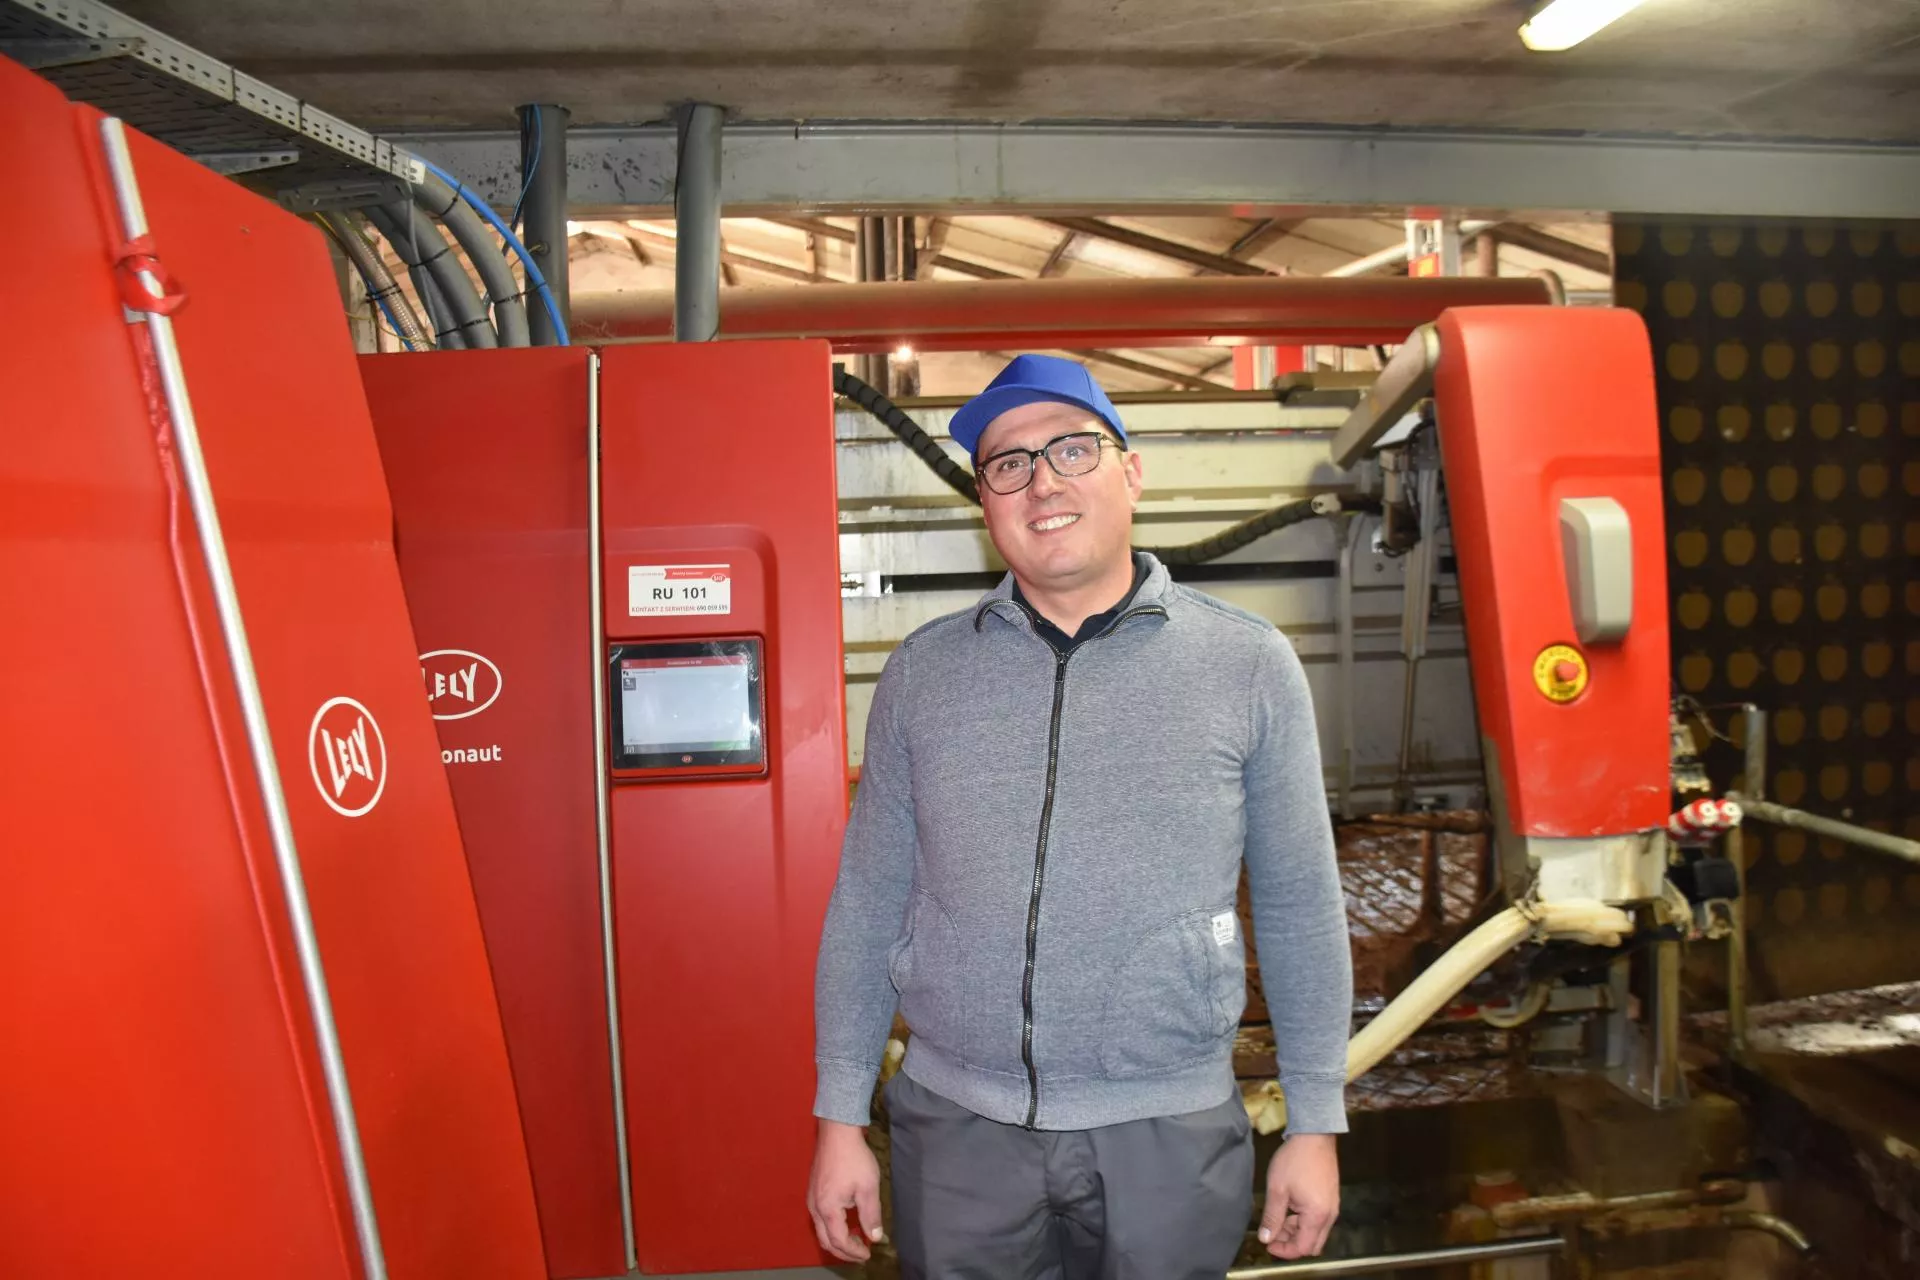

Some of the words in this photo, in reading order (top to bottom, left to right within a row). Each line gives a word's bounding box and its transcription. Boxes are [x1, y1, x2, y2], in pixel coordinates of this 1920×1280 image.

[653, 588, 673, 600] RU
[682, 587, 706, 599] 101
[321, 716, 374, 798] LELY
[441, 744, 502, 763] onaut
